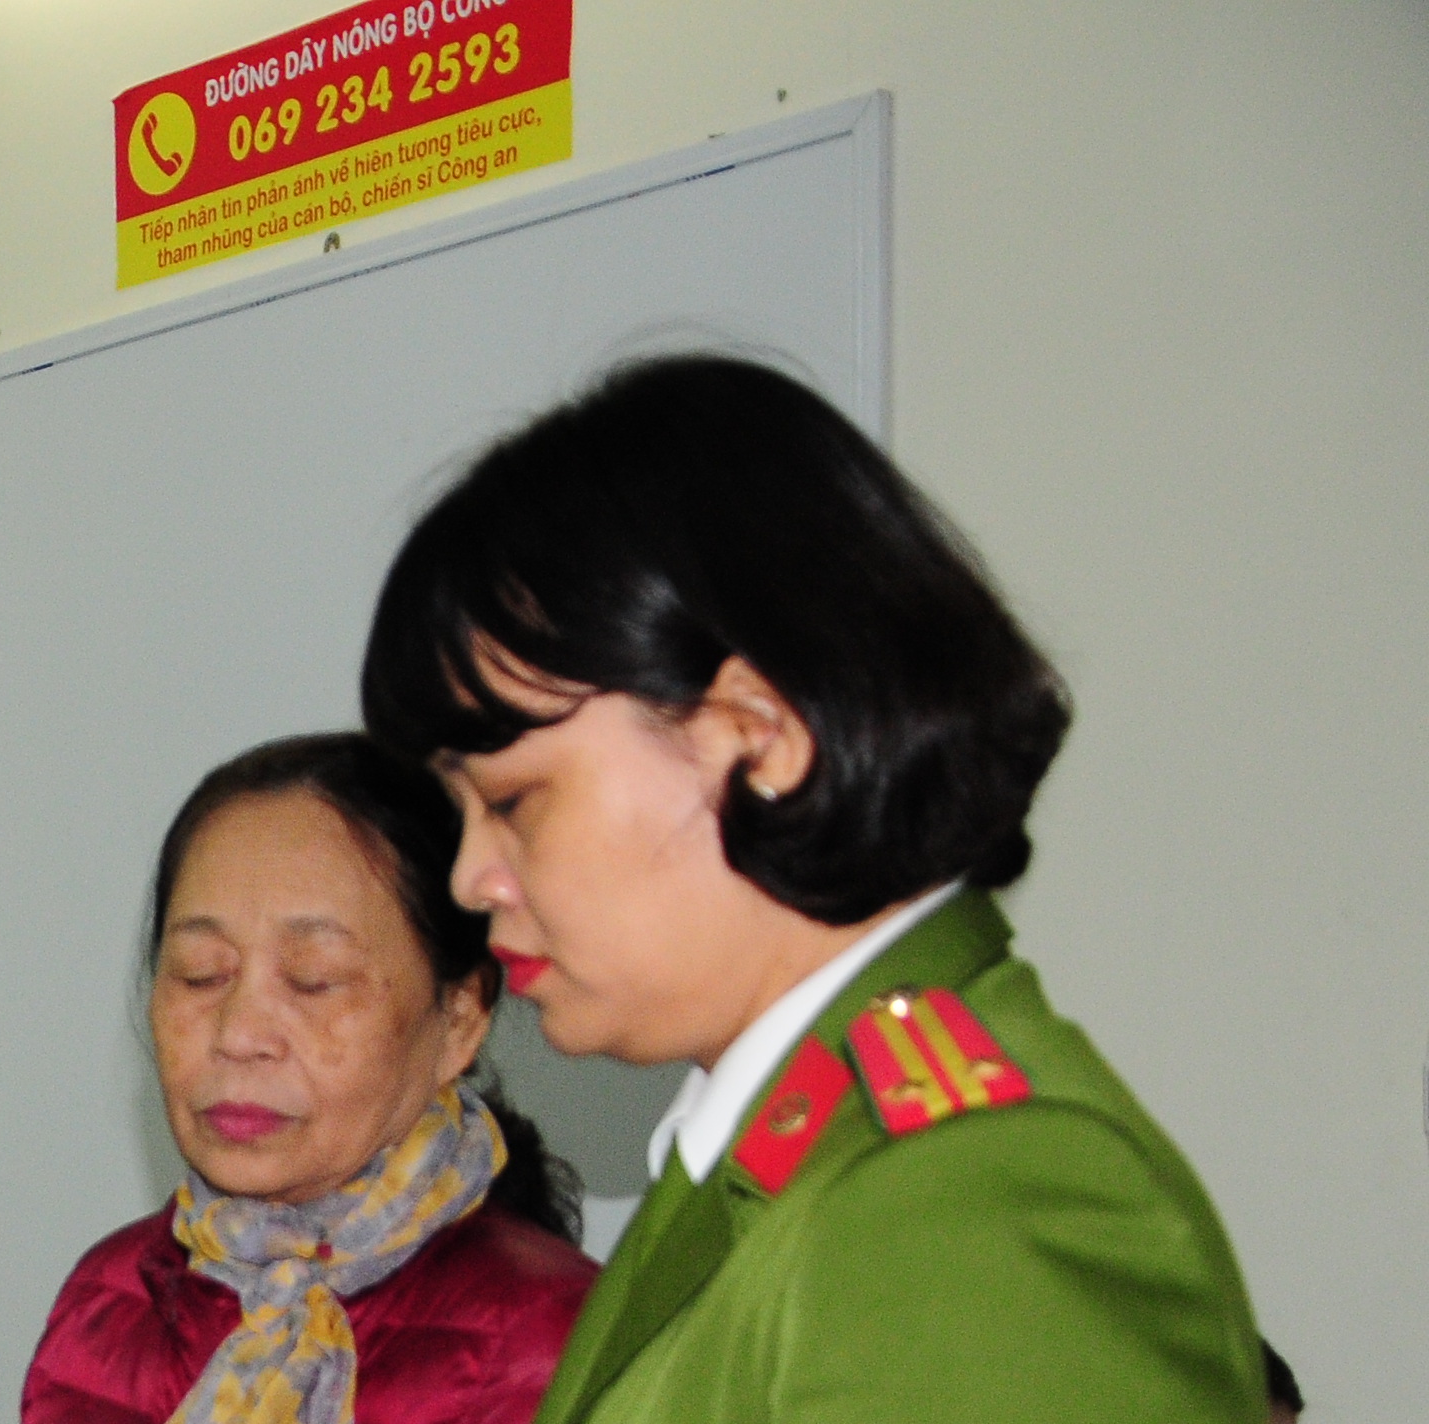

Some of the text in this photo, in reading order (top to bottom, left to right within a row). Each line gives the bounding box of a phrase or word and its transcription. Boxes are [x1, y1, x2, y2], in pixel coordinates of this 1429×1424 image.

[205, 57, 280, 107] ĐƯỜNG
[229, 22, 520, 161] 069 234 2593
[139, 215, 174, 244] Tiếp
[221, 197, 242, 219] tin
[246, 179, 288, 216] phản
[293, 167, 325, 197] ánh
[457, 117, 493, 146] tiêu
[157, 244, 197, 269] tham
[202, 226, 253, 255] nhũng
[257, 211, 289, 239] của
[293, 200, 325, 228] cán
[362, 172, 412, 207] chiến
[417, 166, 433, 191] sĩ
[437, 155, 488, 183] Công
[493, 146, 518, 167] an
